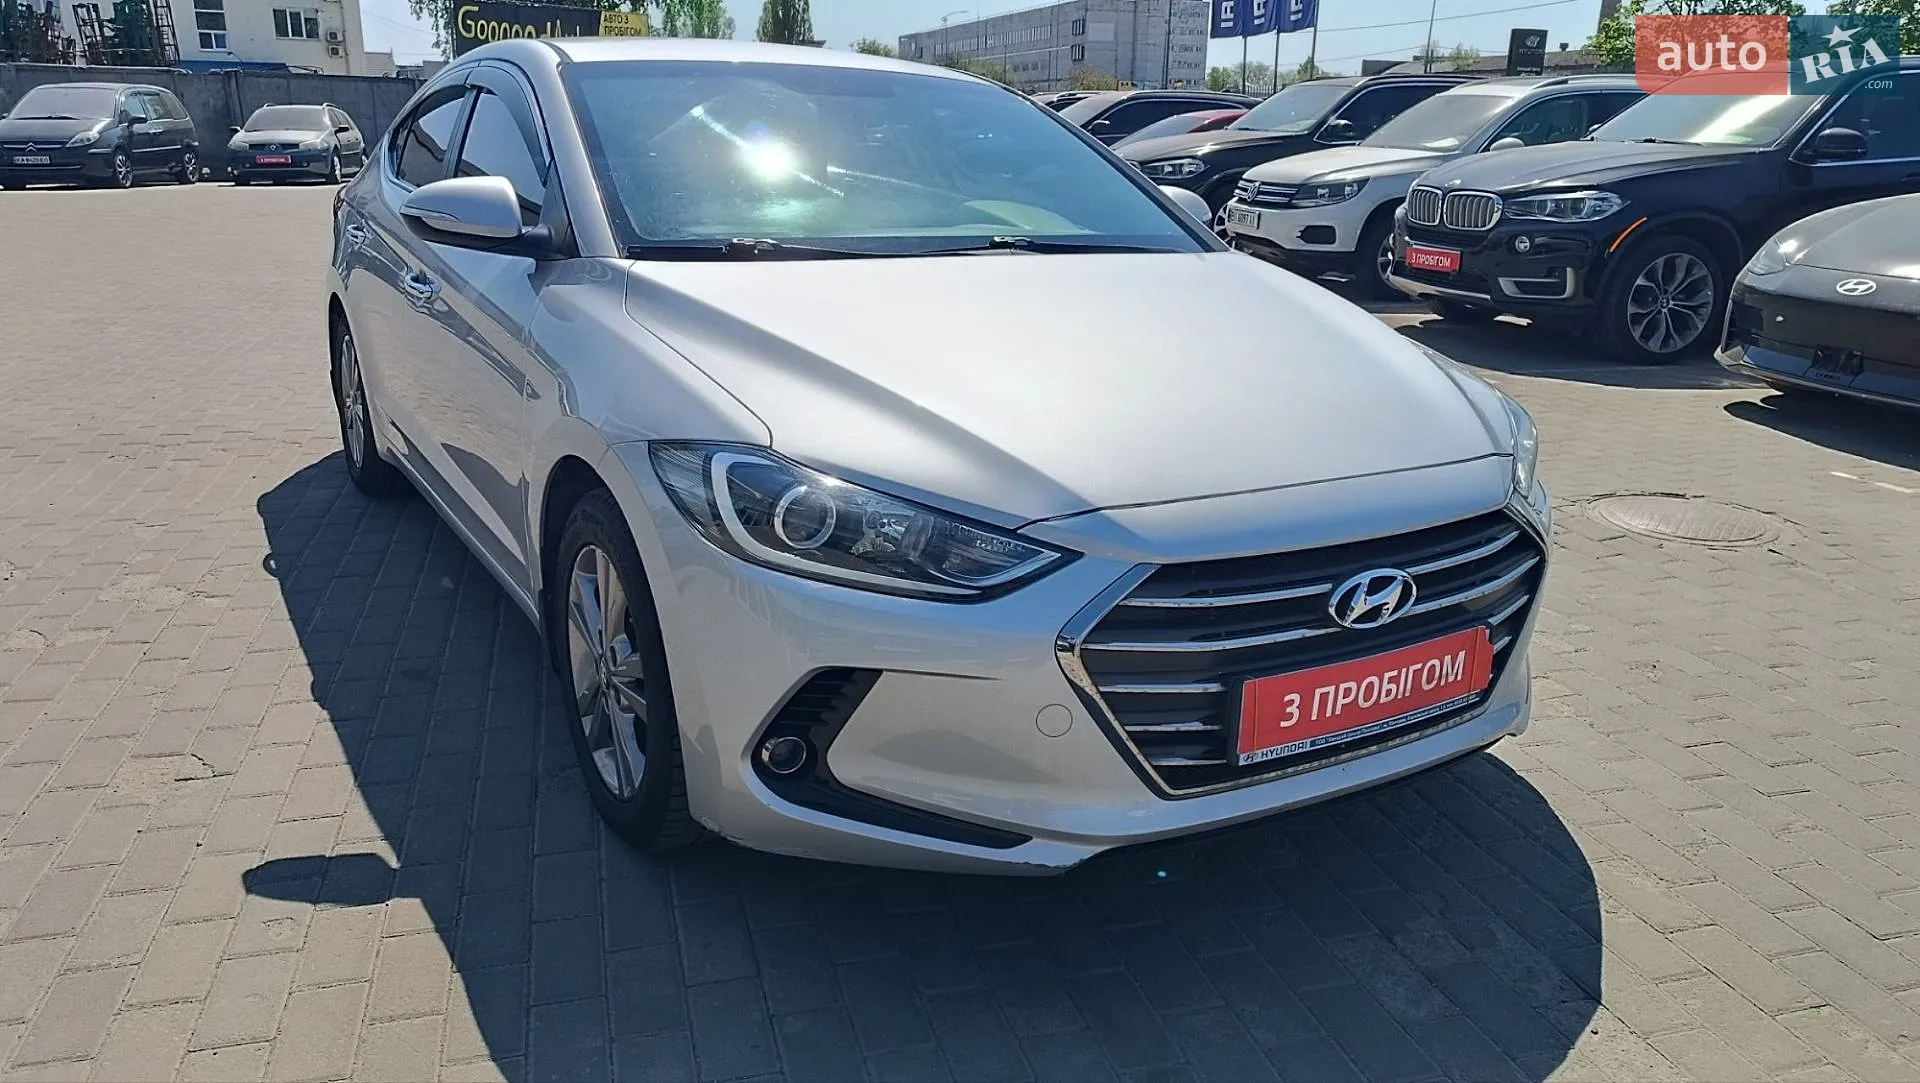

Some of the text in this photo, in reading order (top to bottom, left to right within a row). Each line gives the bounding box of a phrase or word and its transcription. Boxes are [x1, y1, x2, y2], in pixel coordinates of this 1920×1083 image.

[604, 14, 622, 24] АВТО
[1416, 254, 1451, 268] ПРОБІГОМ
[1310, 650, 1466, 721] ПРОБІГОМ
[1261, 741, 1308, 759] HYUNDAI
